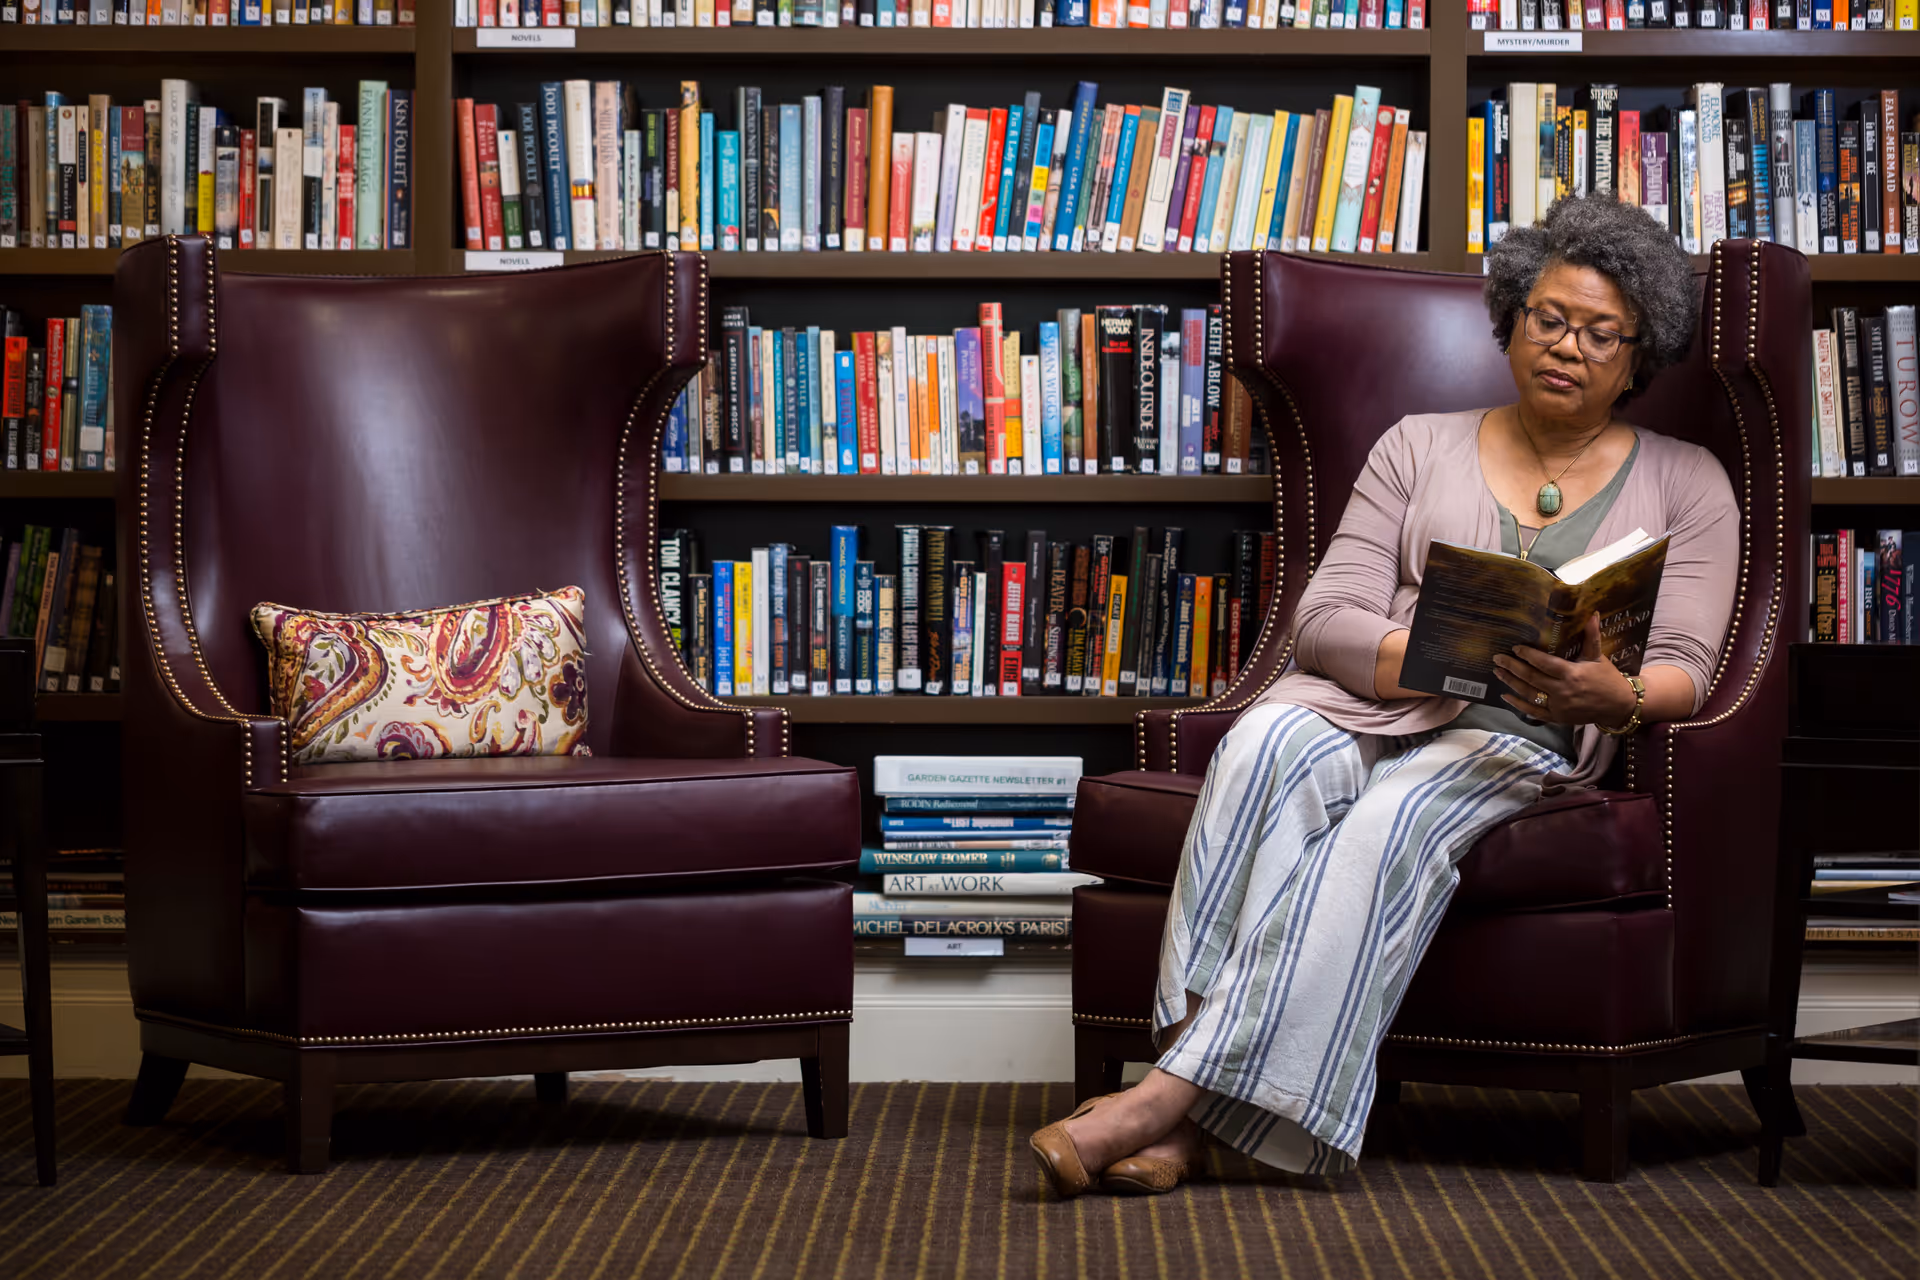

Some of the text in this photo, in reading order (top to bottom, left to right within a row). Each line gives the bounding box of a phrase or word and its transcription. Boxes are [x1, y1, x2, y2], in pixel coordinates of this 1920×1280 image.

[511, 34, 542, 42] NOVELS
[1497, 38, 1570, 47] MYSTERY/MURDER
[1590, 88, 1618, 100] STEPHEN
[1596, 100, 1612, 111] KING
[544, 86, 560, 172] JODI PICOULT
[747, 100, 756, 156] CLOUD NINE
[1596, 117, 1612, 138] THE
[1701, 94, 1711, 143] LEONARD
[1710, 97, 1720, 140] ELMORE
[361, 90, 372, 193] FANNIE FLAGG
[393, 99, 408, 187] KEN FOLLETT
[521, 107, 537, 182] JODI PICOULT
[1885, 98, 1896, 193] FALSE MERMAID
[1773, 165, 1793, 176] THE
[1773, 176, 1793, 186] BIG
[1866, 162, 1876, 175] ICE
[1065, 194, 1074, 214] SEE
[1774, 186, 1794, 199] LAW
[748, 208, 757, 228] RICE
[1704, 195, 1714, 229] DEAKY
[1714, 190, 1724, 232] FREAKY
[1820, 193, 1828, 231] MURDER
[1828, 193, 1836, 229] CAPITOL
[499, 257, 530, 265] NOVELS
[1101, 318, 1133, 327] HERMAN
[1844, 310, 1856, 336] SCOTT
[1872, 326, 1882, 351] SCOTT
[1044, 334, 1058, 421] SUSAN WIGGS
[1207, 317, 1222, 407] KEITH ABLOW
[1817, 331, 1833, 416] MARTIN CRUZ SMITH
[1140, 328, 1154, 431] INSIDE OUTSIDE
[1896, 335, 1919, 446] TUROW
[788, 424, 796, 453] TYLE
[902, 528, 919, 565] PATRICIA
[1162, 532, 1171, 584] emerson
[661, 538, 681, 625] TOM CLANCY
[928, 531, 945, 621] PATRICIA CORNWELL
[1050, 569, 1066, 613] DEAVER
[1881, 570, 1902, 610] 1776
[1006, 582, 1021, 642] JEFFERY DEAVER
[1112, 594, 1121, 619] HEART
[1600, 610, 1630, 630] AURA
[1074, 629, 1085, 645] TIM
[1177, 600, 1191, 663] Janet Evanovich
[1231, 637, 1239, 652] TO
[908, 774, 946, 783] GARDEN
[948, 774, 990, 784] GAZETTE
[993, 776, 1054, 785] NEWSLETTER
[901, 799, 932, 808] RODIN
[873, 853, 988, 865] WINSLOW HOMER
[888, 876, 927, 892] ART
[940, 876, 1004, 892] WORK
[853, 921, 1065, 935] MICHEL DELACROIX'S PARIS
